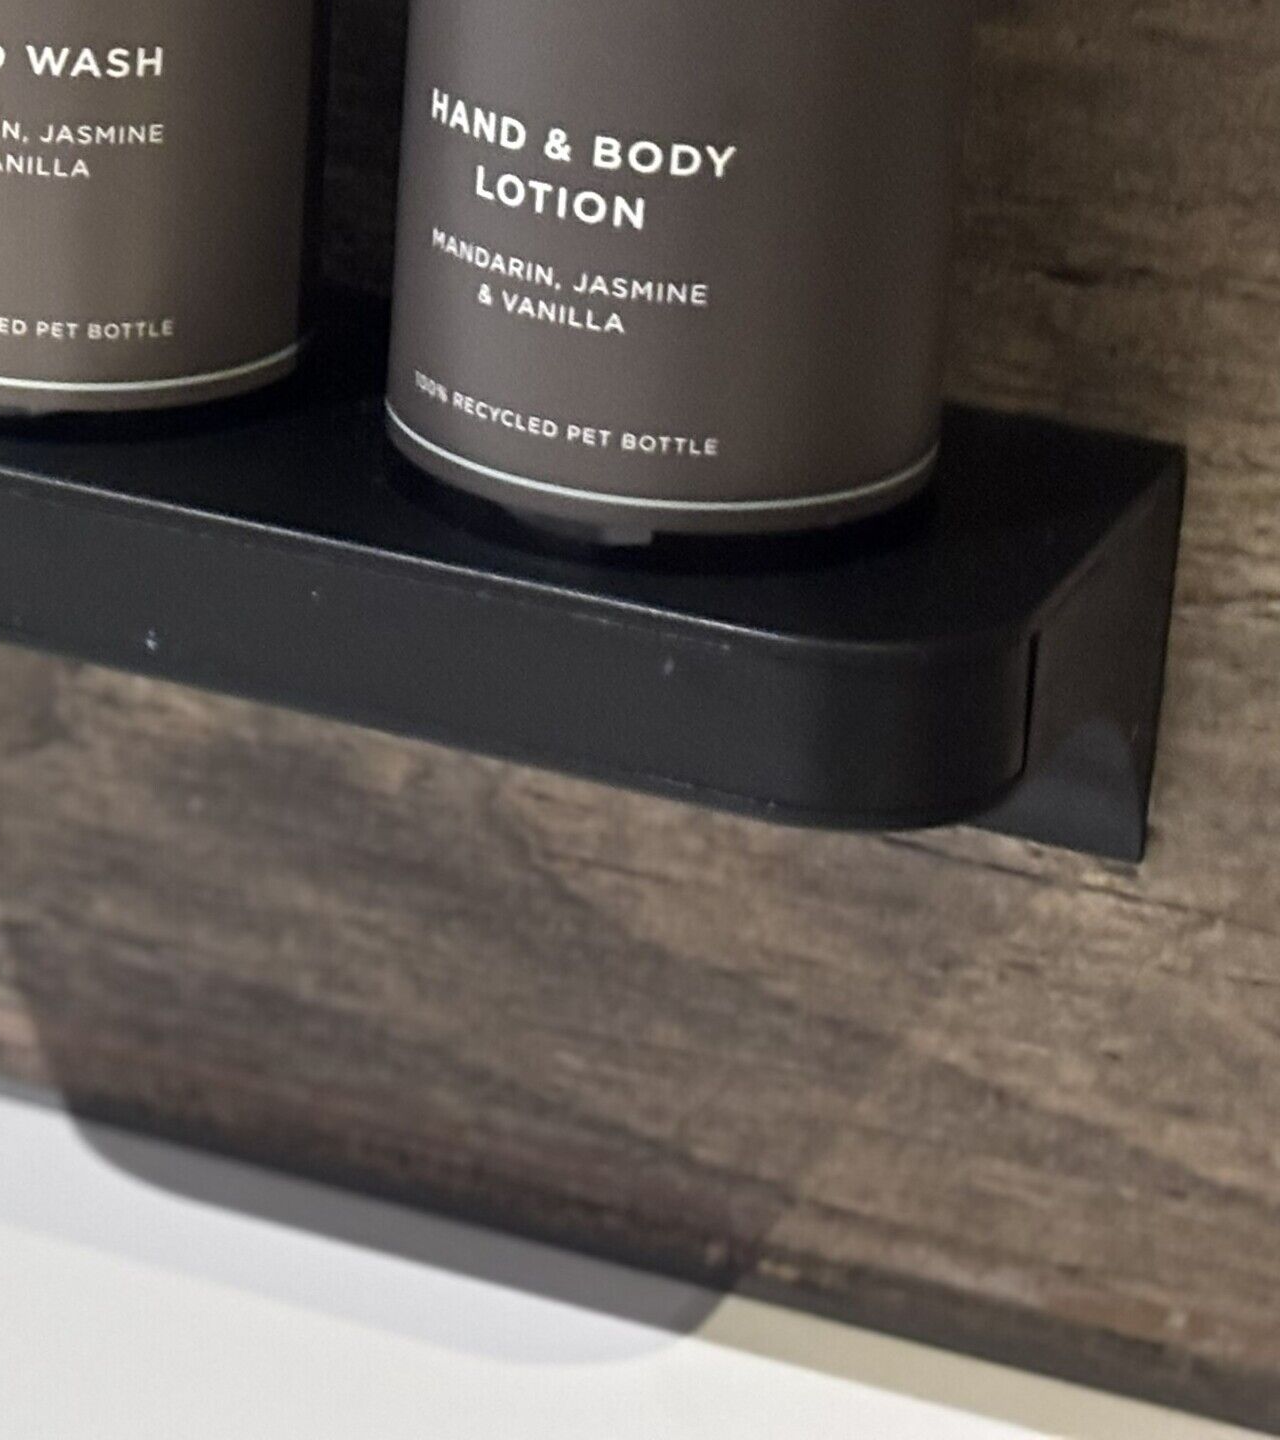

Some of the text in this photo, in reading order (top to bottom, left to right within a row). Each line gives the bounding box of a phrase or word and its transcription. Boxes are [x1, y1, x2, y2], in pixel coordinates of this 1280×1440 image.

[26, 45, 164, 78] WASH
[40, 123, 164, 144] JASMINE
[431, 88, 736, 178] HAND & BODY
[475, 165, 646, 230] LOTION
[432, 228, 709, 306] MANDARIN, JASMINE
[37, 321, 77, 338] PET
[88, 320, 174, 339] BOTTLE
[477, 284, 625, 334] & VANILLA
[415, 370, 718, 455] 100% RECYCLED PET BOTTLE
